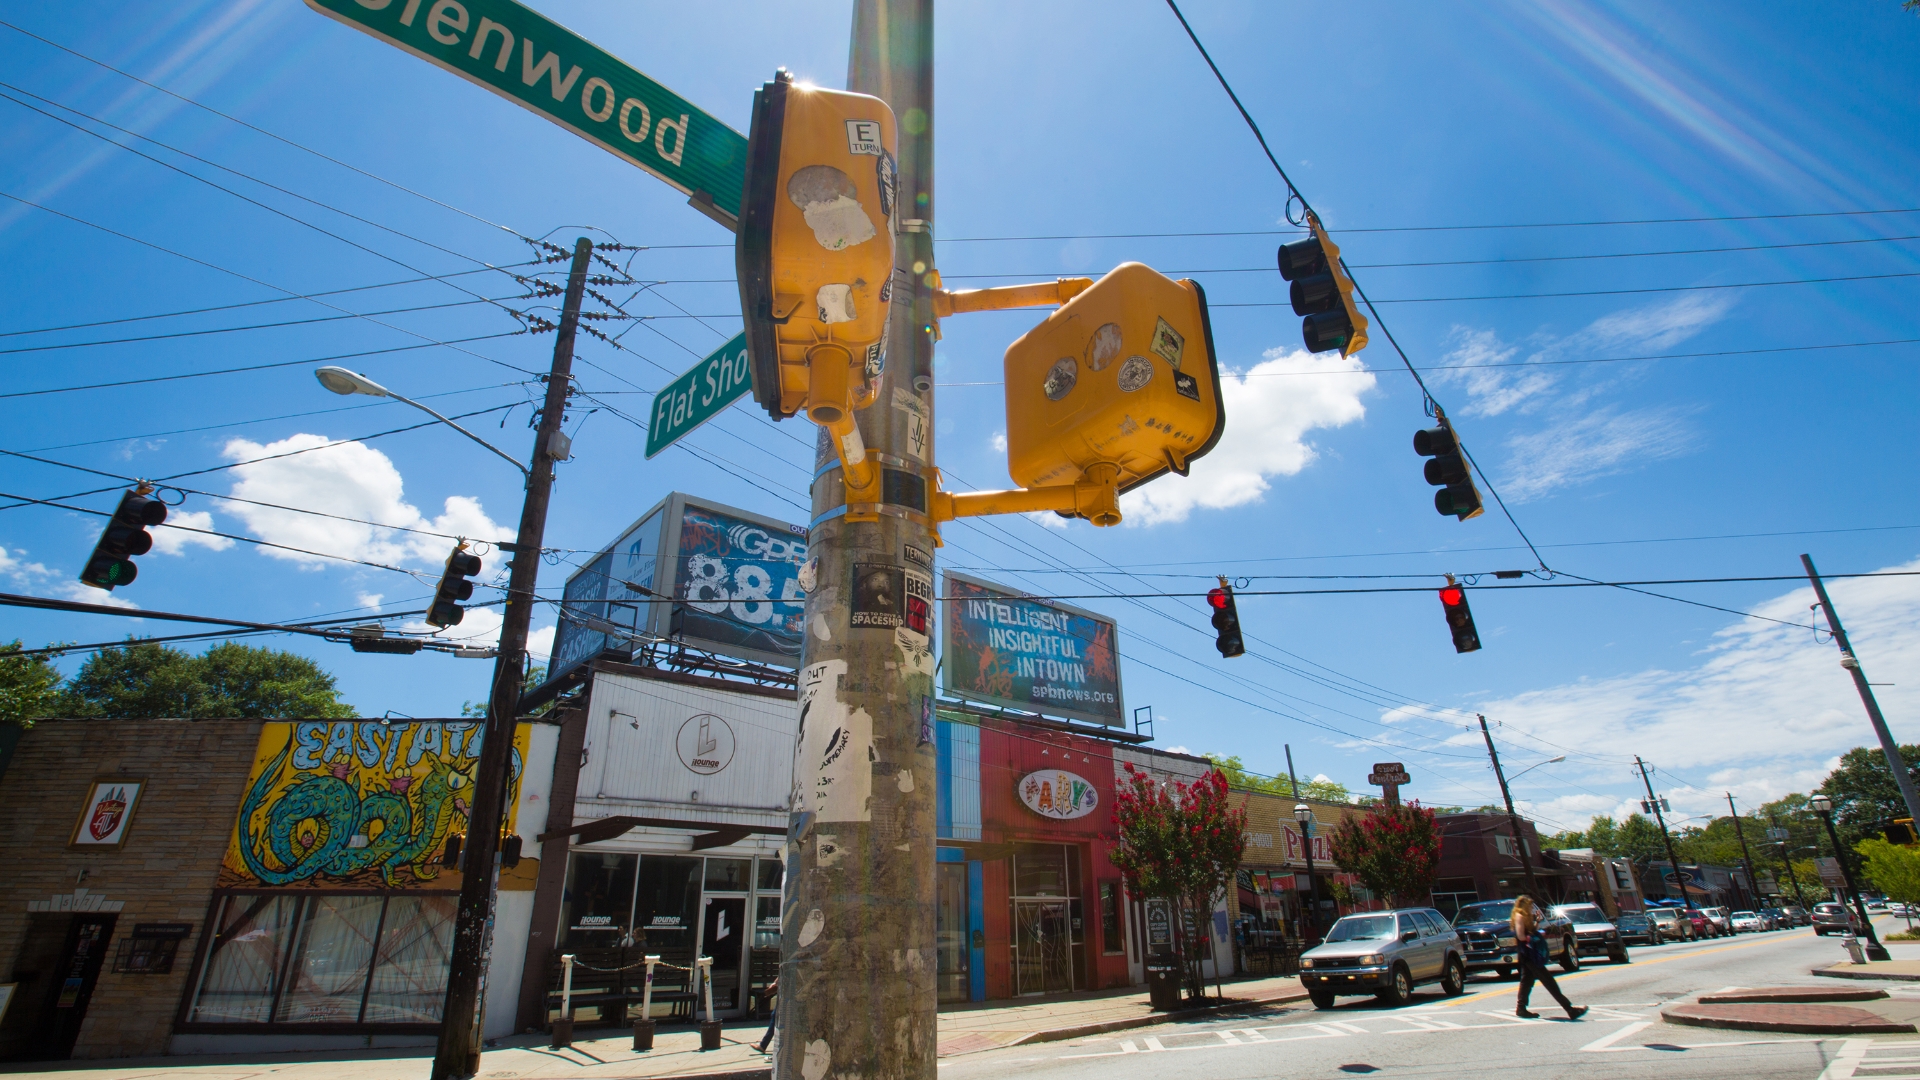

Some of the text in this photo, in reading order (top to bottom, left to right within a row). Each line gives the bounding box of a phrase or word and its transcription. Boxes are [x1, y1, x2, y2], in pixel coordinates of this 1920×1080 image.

[356, 0, 690, 167] enwood
[856, 124, 874, 142] E
[852, 143, 880, 154] TURN
[653, 348, 751, 442] Flat Sho
[852, 615, 904, 627] SPACESHIP
[968, 600, 1069, 636] INTELLIGENT
[989, 627, 1081, 660] INSIGHTFUL
[1017, 656, 1086, 684] INTOWN
[1032, 683, 1115, 704] gpbnews.org
